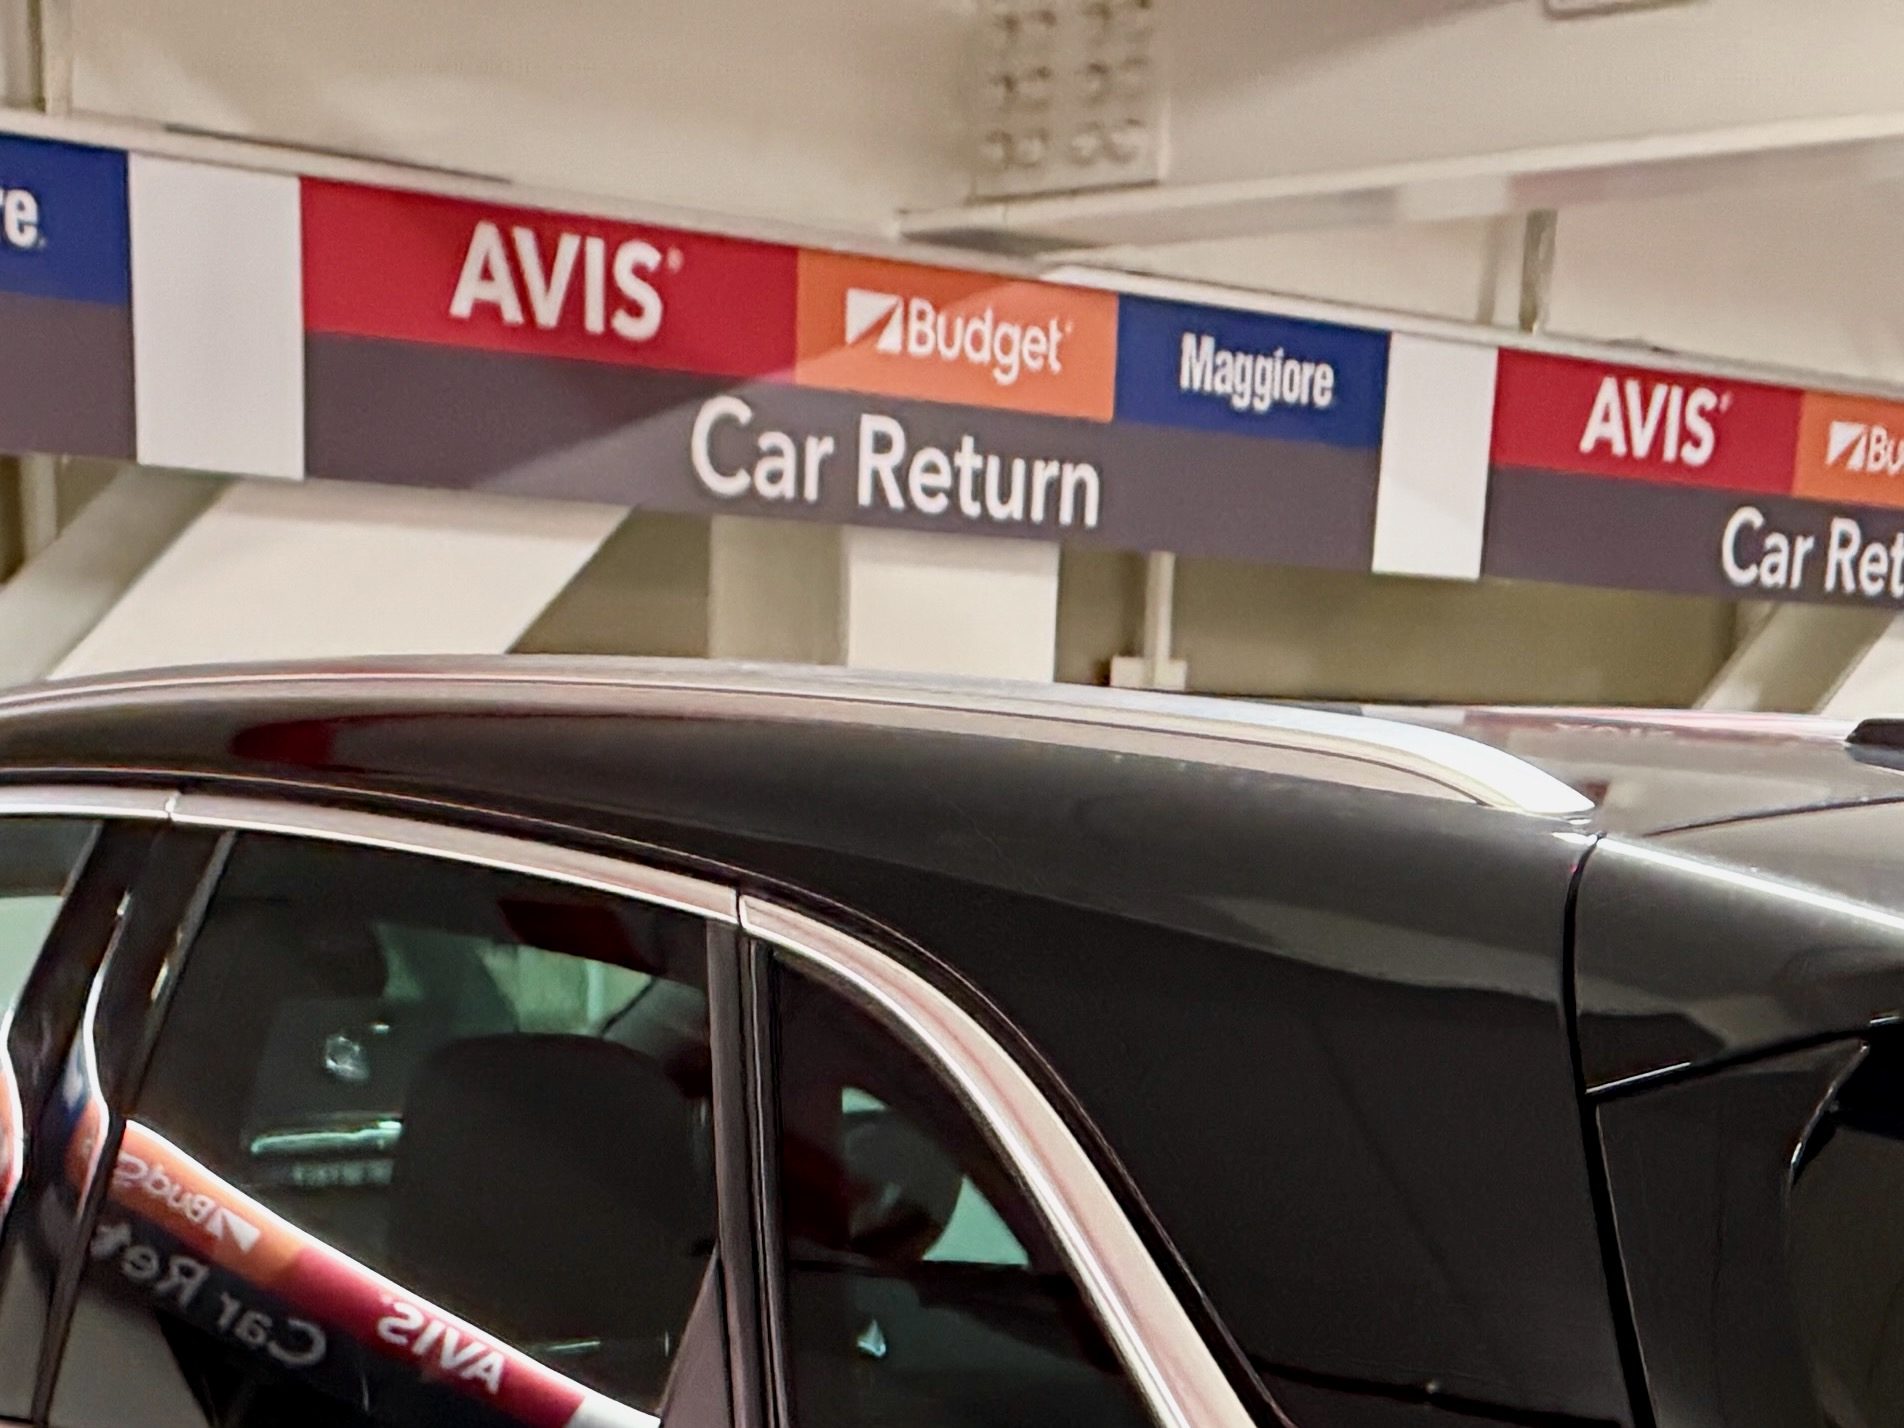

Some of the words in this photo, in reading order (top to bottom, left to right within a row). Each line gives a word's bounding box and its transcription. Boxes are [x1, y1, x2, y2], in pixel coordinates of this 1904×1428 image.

[449, 222, 664, 341] AVIS
[907, 298, 1062, 386] Budget
[1180, 331, 1335, 412] Maggiore
[691, 395, 835, 502] Car
[857, 413, 1100, 528] Return
[1580, 376, 1718, 468] AVIS
[1722, 505, 1815, 590] Car
